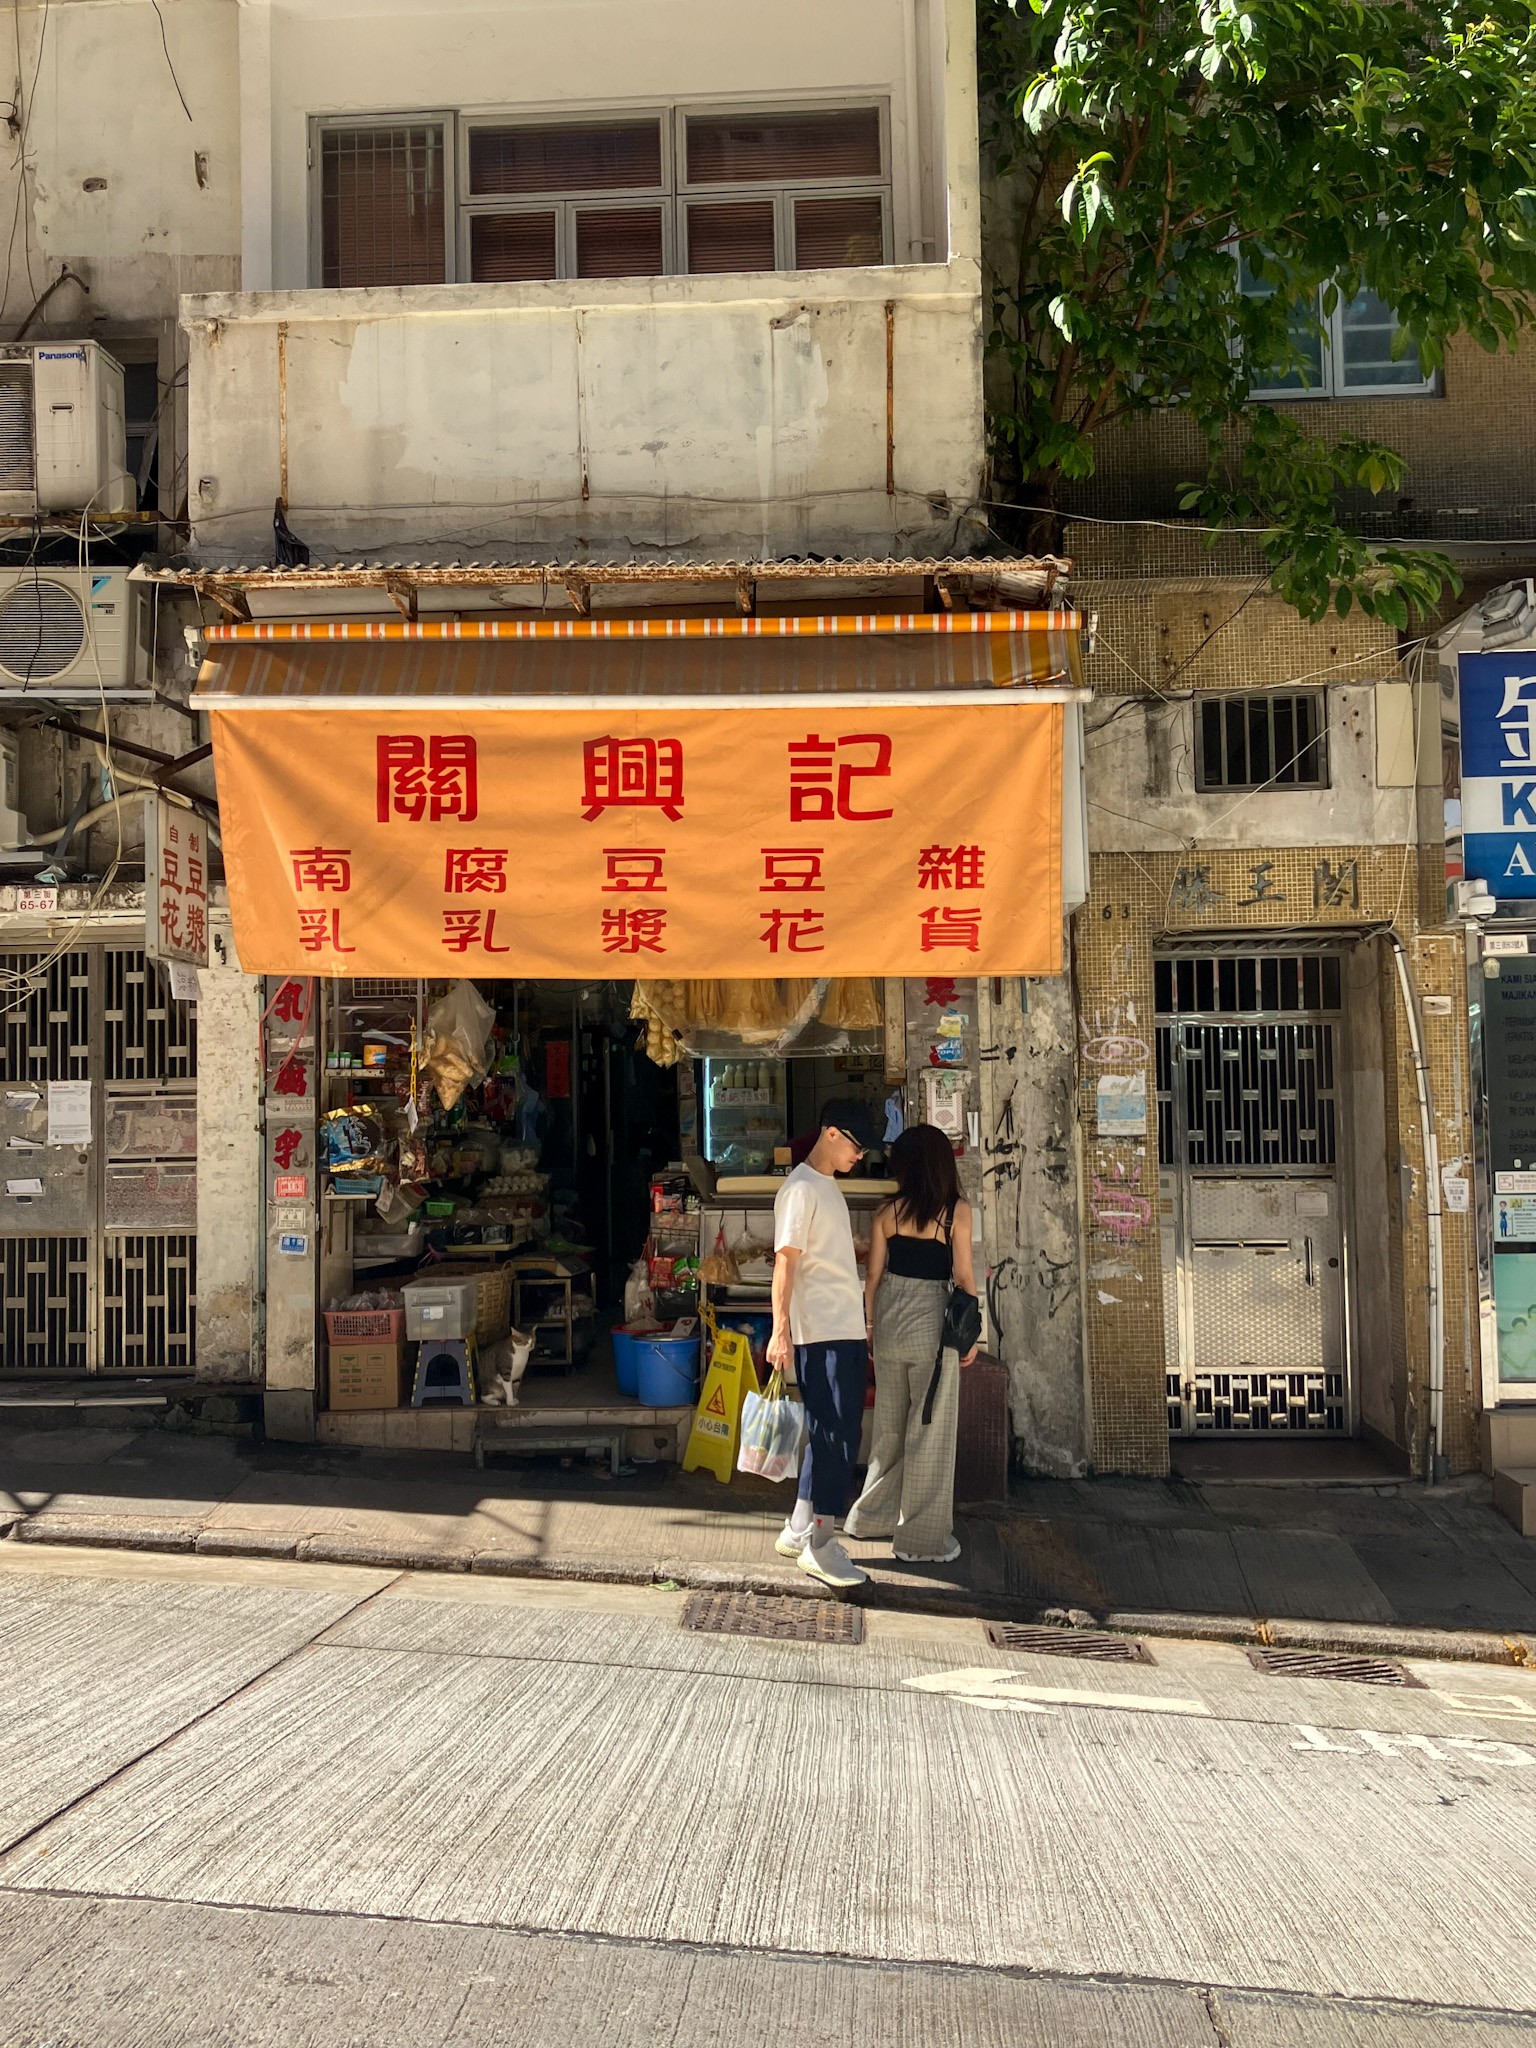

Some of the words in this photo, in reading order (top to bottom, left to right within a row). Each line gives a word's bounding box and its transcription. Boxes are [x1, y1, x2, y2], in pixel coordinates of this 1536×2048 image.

[38, 351, 86, 361] Panasonic
[377, 734, 893, 822] 關興記
[1503, 841, 1536, 877] A
[20, 899, 54, 910] 65-67
[160, 848, 183, 948] 豆花
